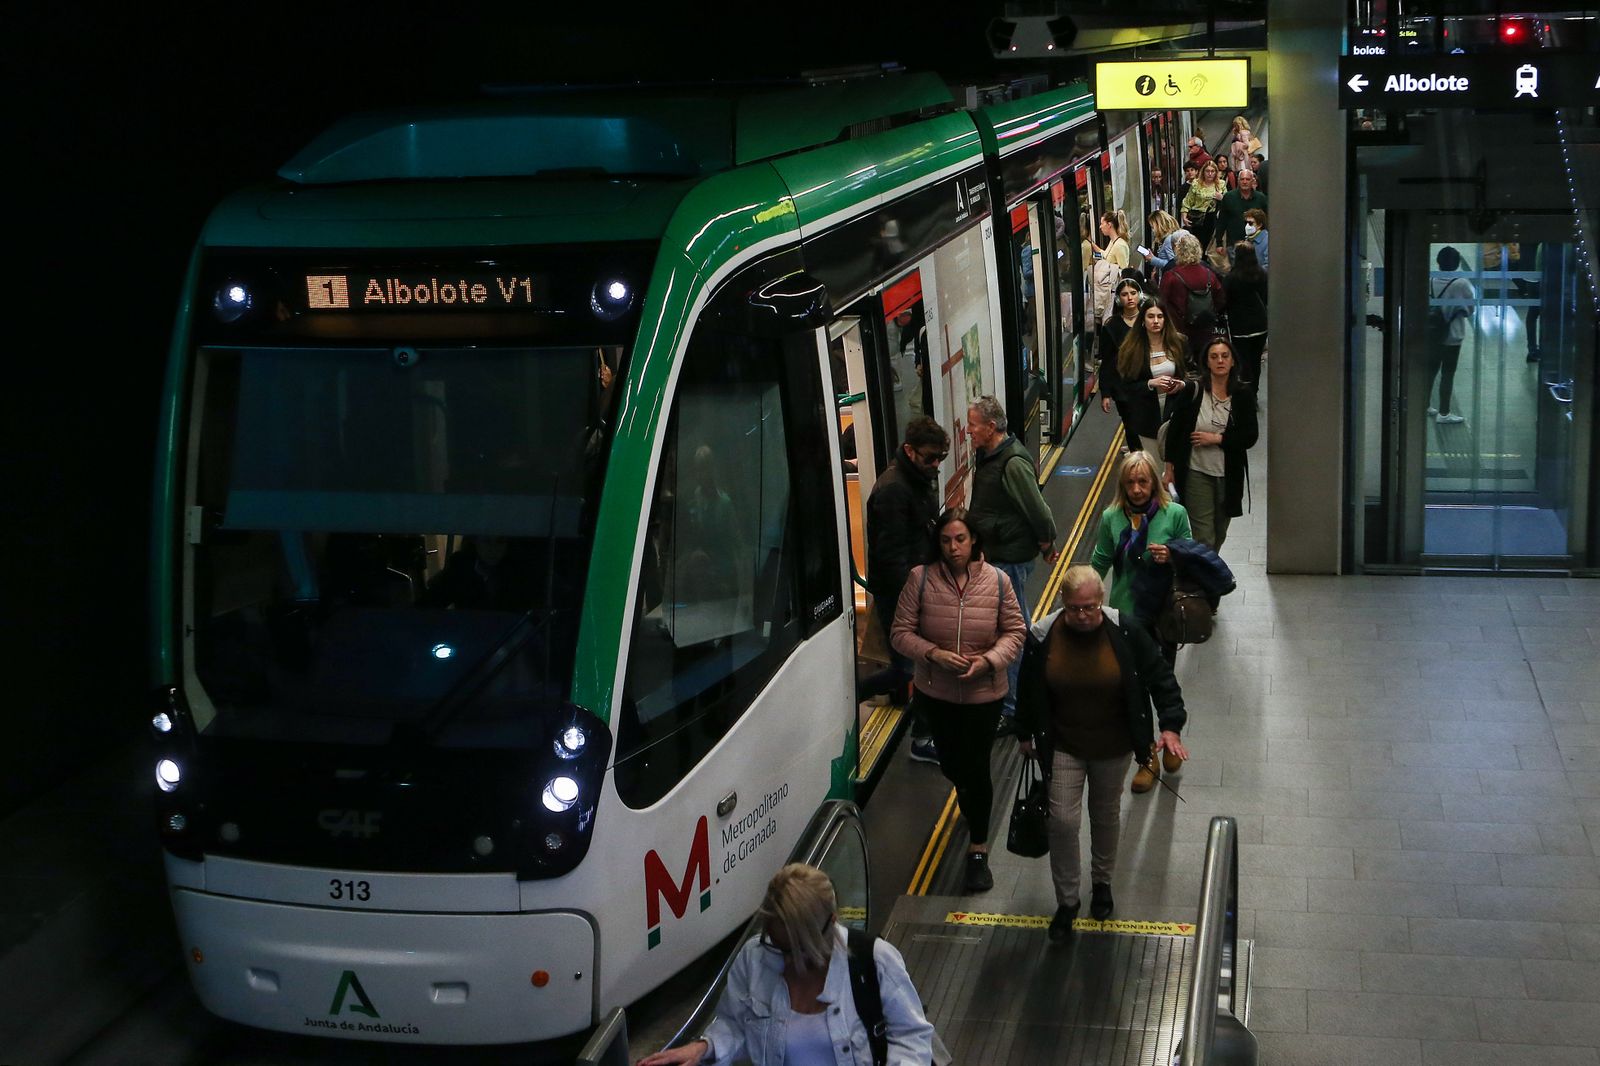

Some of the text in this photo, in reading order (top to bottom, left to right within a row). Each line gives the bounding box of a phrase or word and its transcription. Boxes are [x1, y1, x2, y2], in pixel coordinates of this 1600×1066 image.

[1353, 45, 1386, 55] bolote
[1384, 73, 1469, 92] Albolote
[363, 277, 488, 304] Albolote
[496, 276, 533, 303] V1
[316, 808, 383, 840] CAF
[721, 783, 790, 848] Metropolitano
[723, 818, 777, 875] de Granada
[329, 879, 371, 901] 313
[968, 915, 1028, 925] SEGURIDAD
[1116, 922, 1173, 931] MANTENGA
[303, 1017, 337, 1030] Junta
[340, 1020, 355, 1031] de
